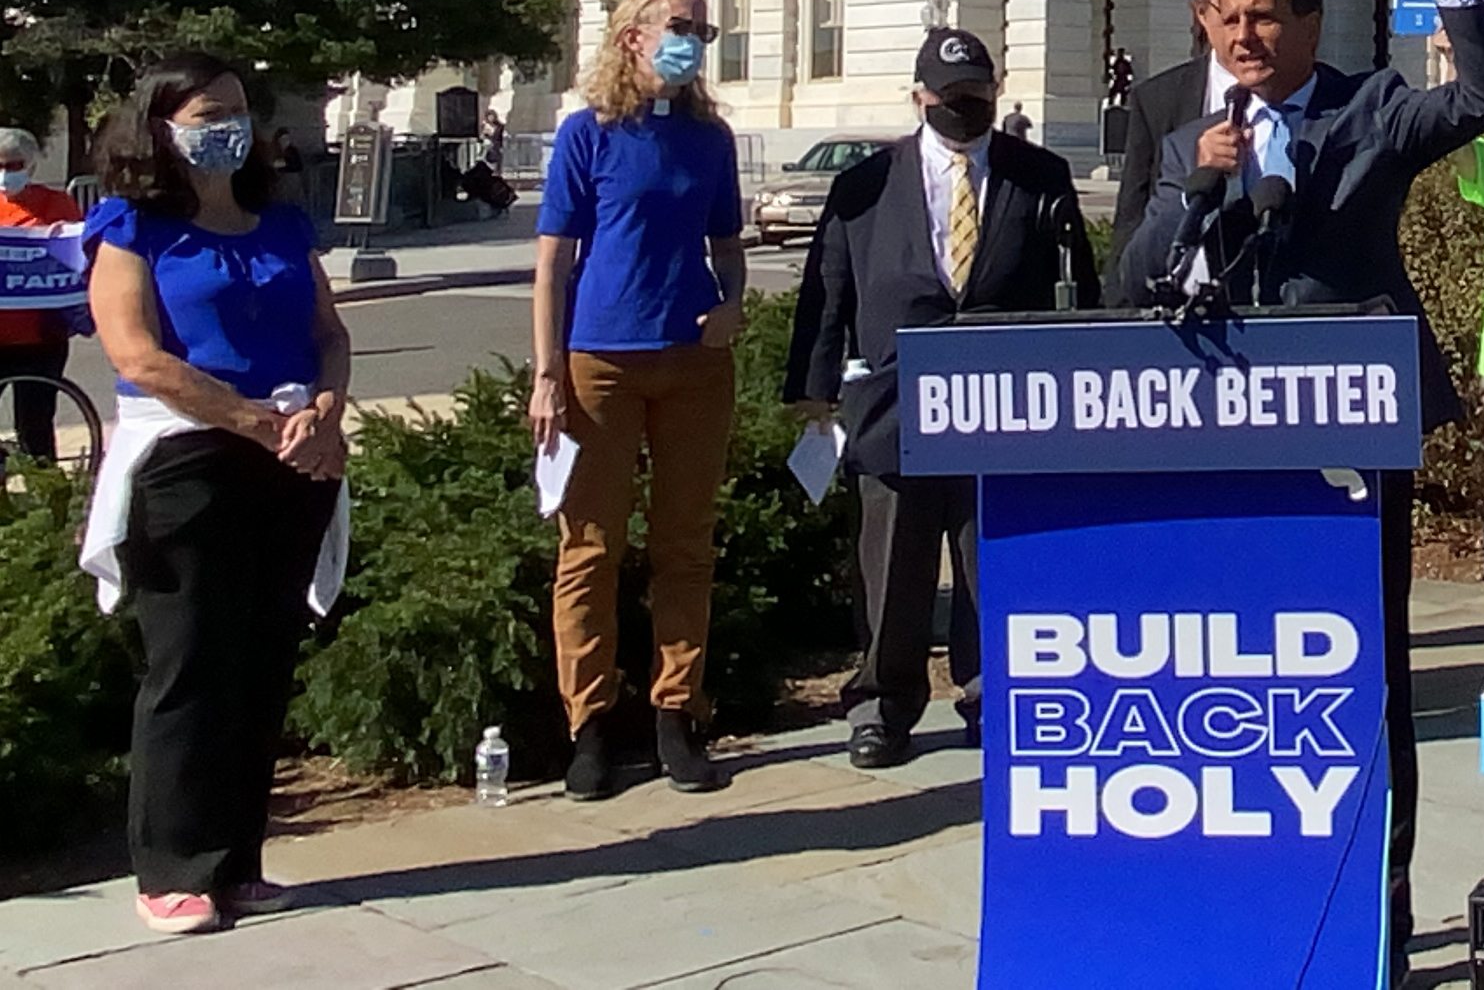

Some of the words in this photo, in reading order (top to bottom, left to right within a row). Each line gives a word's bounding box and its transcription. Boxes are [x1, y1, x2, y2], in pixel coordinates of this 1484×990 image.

[918, 372, 1059, 434] BUILD
[1072, 367, 1202, 430] BACK
[1215, 364, 1399, 427] BETTER
[1007, 612, 1360, 679] BUILD
[1009, 687, 1356, 757] BACK
[1009, 763, 1361, 839] HOLY
